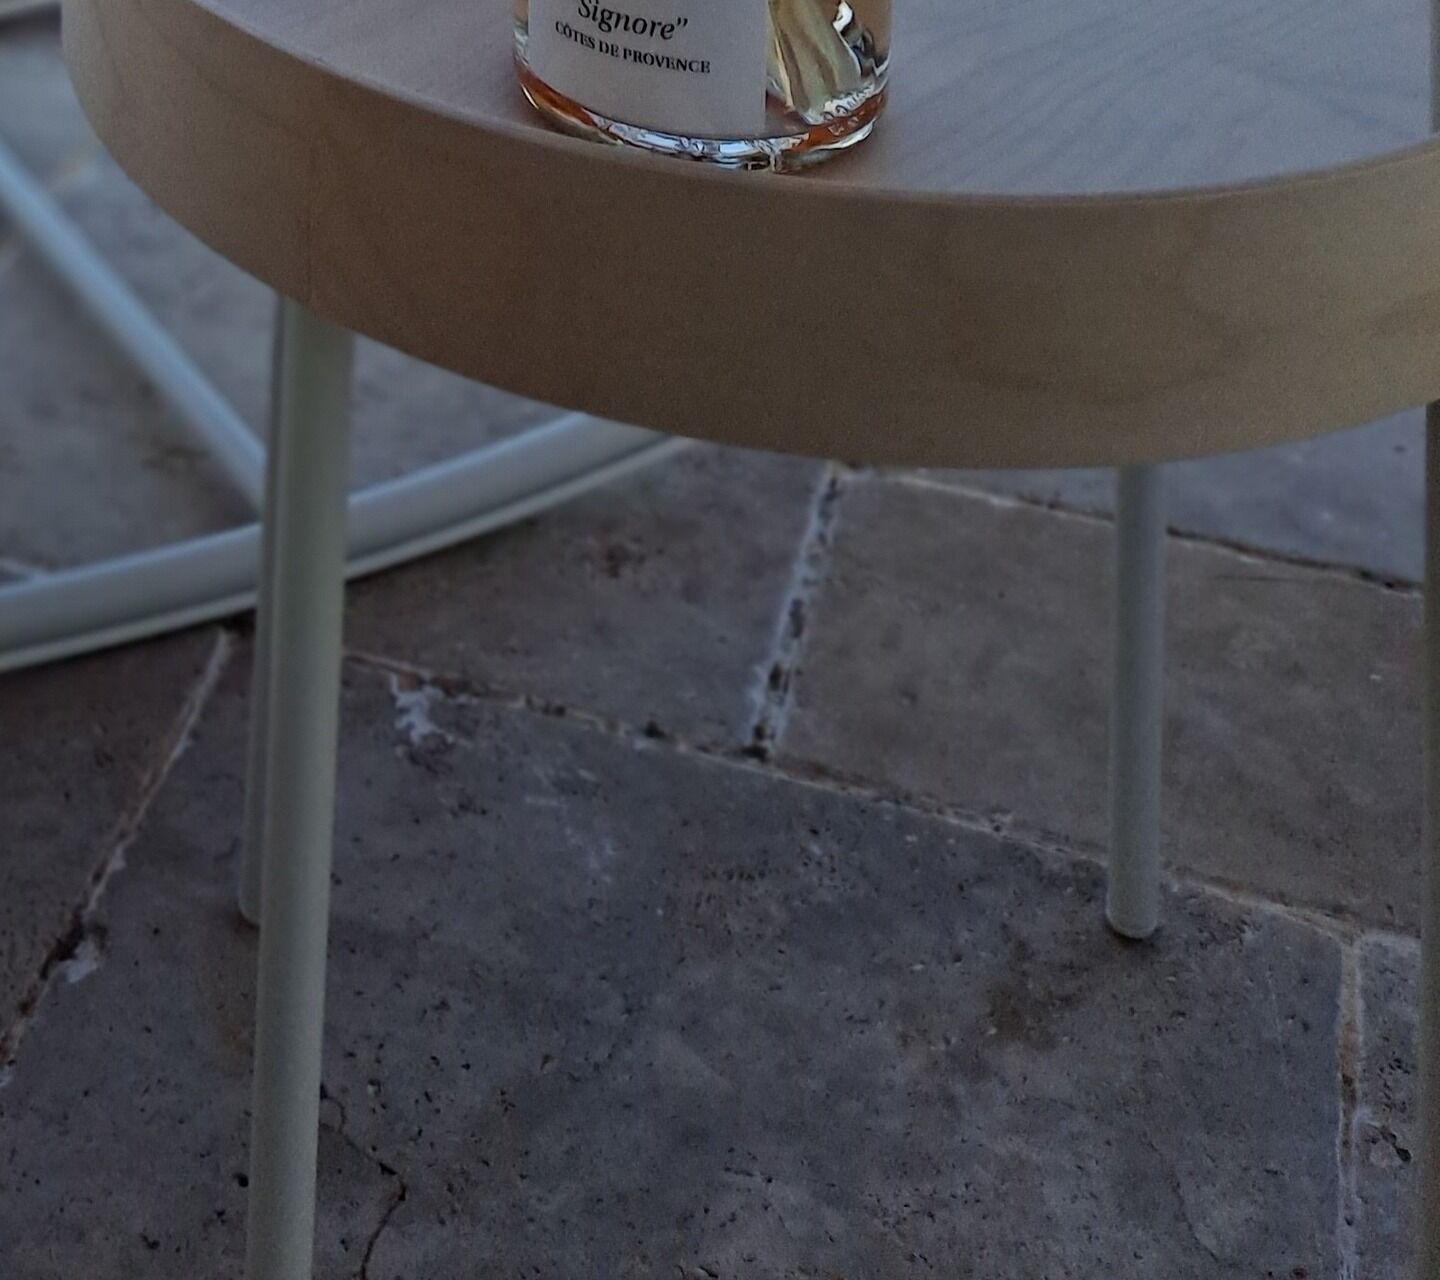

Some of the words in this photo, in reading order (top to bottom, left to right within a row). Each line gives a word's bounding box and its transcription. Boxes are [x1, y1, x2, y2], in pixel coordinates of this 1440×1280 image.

[555, 20, 596, 50] CÔTES
[599, 40, 620, 58] DE
[623, 47, 711, 74] PROVENCE
